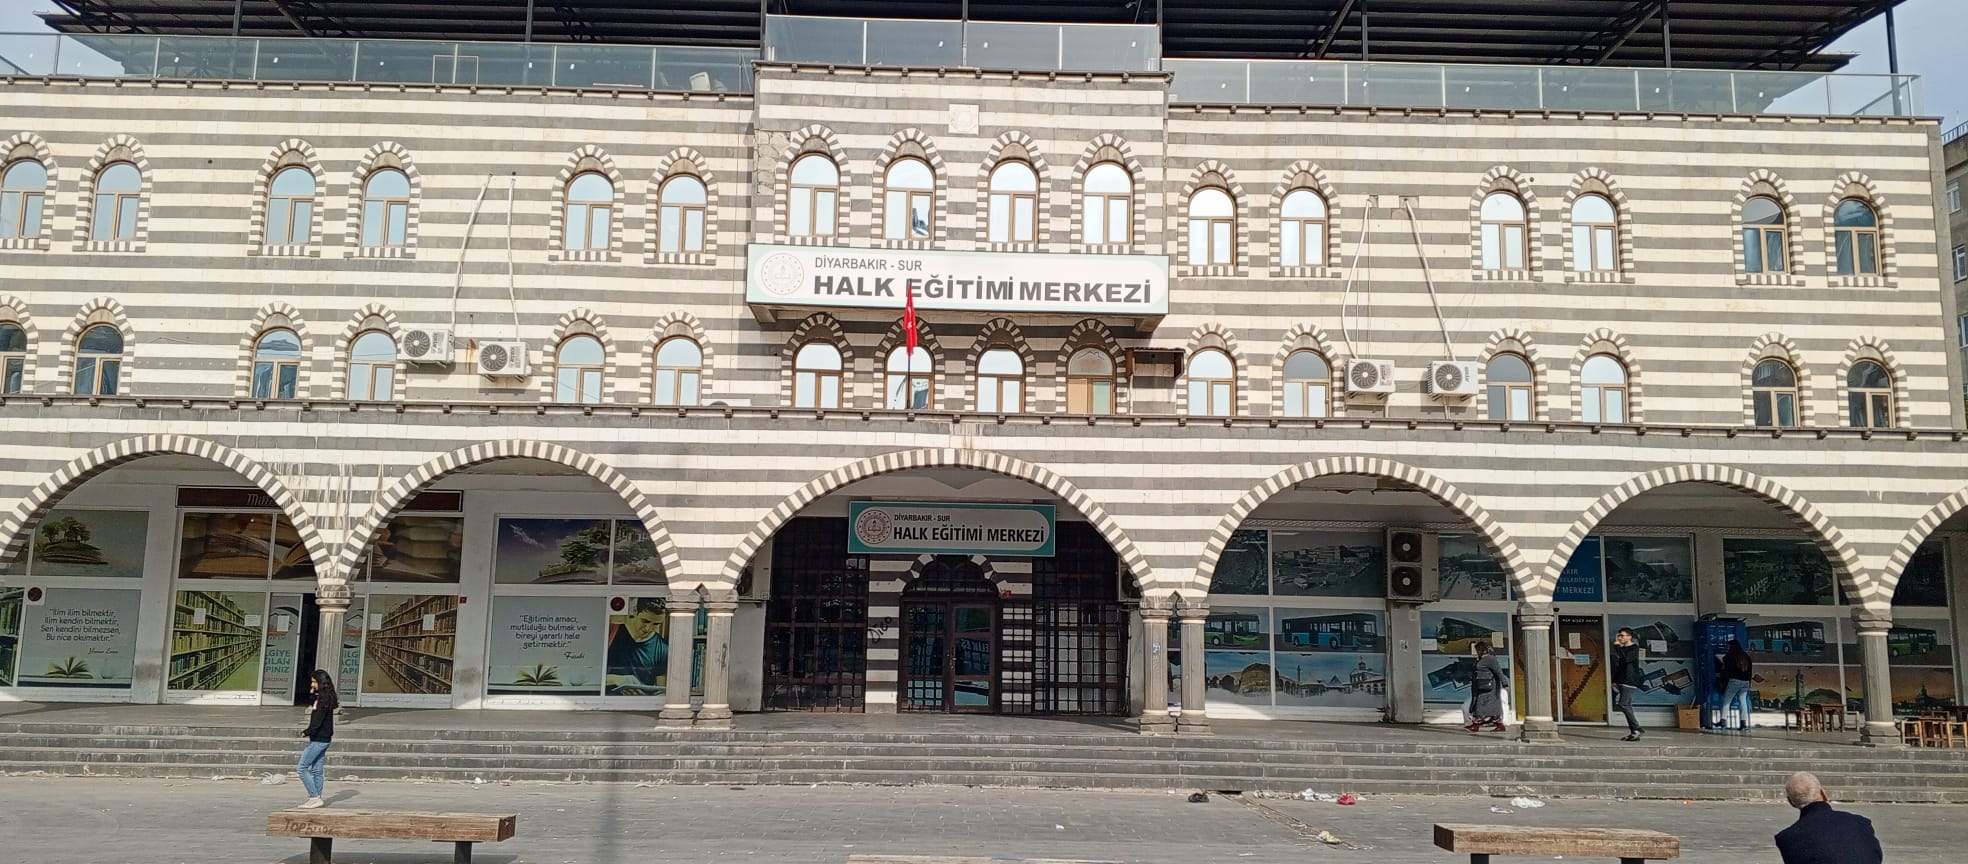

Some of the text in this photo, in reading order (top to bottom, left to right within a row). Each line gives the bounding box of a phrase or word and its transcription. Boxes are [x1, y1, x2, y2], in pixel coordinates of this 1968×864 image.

[815, 254, 887, 270] DİYARBAKIR
[897, 260, 922, 271] SUR
[814, 274, 1151, 303] HALK EĞİTİMİ MERKEZİ
[894, 513, 932, 522] DİYARBAKIR
[937, 514, 950, 522] SUR
[893, 524, 1044, 542] HALK EĞİTİMİ MERKEZİ
[1562, 586, 1595, 594] MERKEZİ
[59, 617, 83, 625] kendin
[41, 624, 54, 633] Sen
[55, 625, 82, 633] kendini
[510, 623, 546, 633] mutluluğu
[46, 633, 55, 641] Bu
[515, 632, 580, 641] bireyi yararlı hale
[267, 648, 290, 657] GİYE
